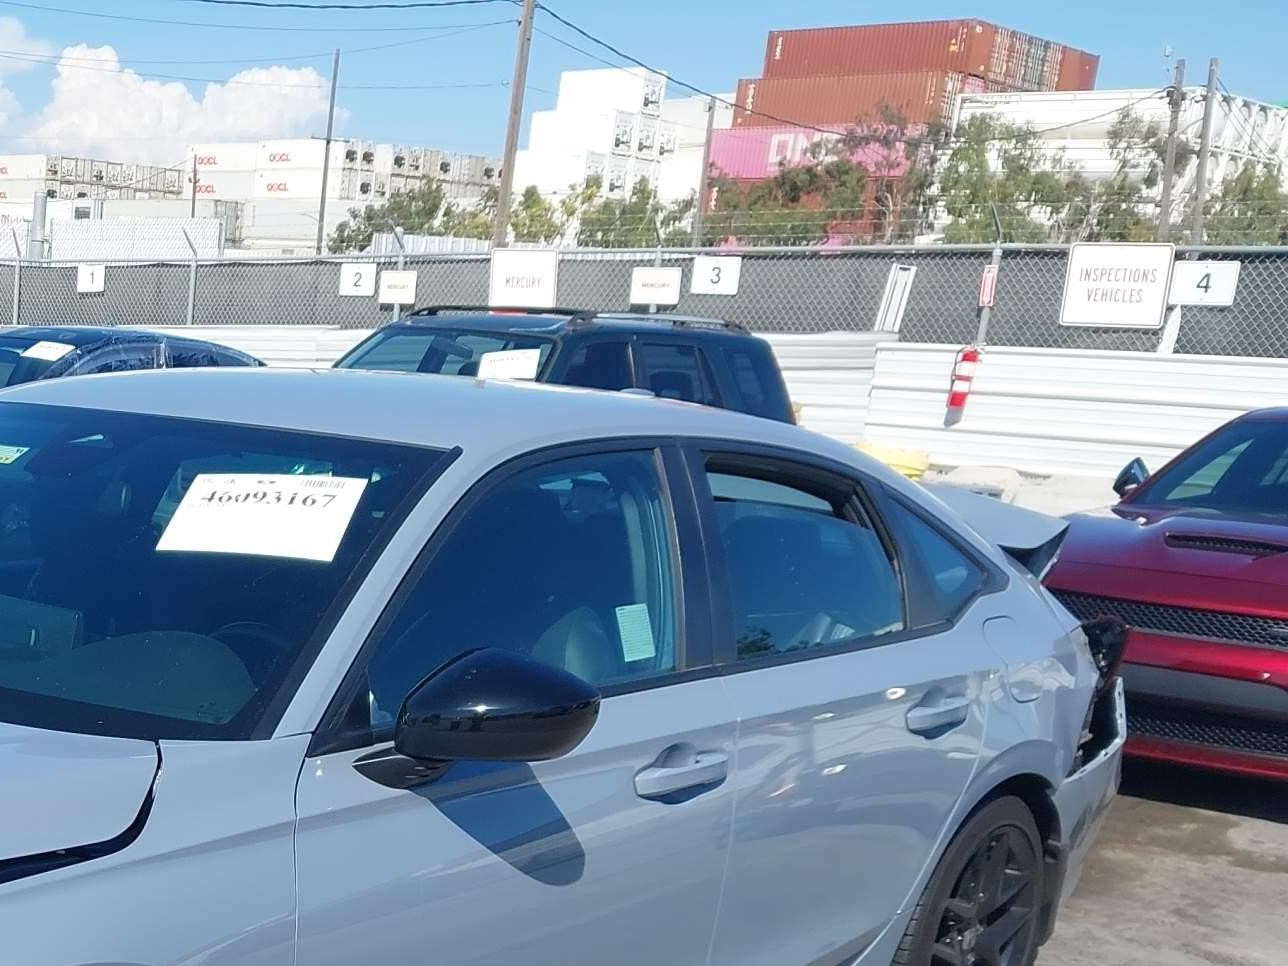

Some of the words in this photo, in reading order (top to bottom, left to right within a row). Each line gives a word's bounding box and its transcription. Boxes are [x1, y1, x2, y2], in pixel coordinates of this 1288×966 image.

[197, 157, 217, 165] OOCL
[269, 153, 291, 162] OOCL
[195, 184, 216, 193] OOCL
[266, 183, 288, 192] OOCL
[353, 271, 362, 287] 2
[505, 276, 542, 288] MERCURY
[710, 266, 722, 285] 3
[1079, 267, 1158, 283] INSPECTIONS
[1196, 272, 1212, 294] 4
[1087, 288, 1143, 303] VEHICLES
[201, 490, 337, 508] 46093167
